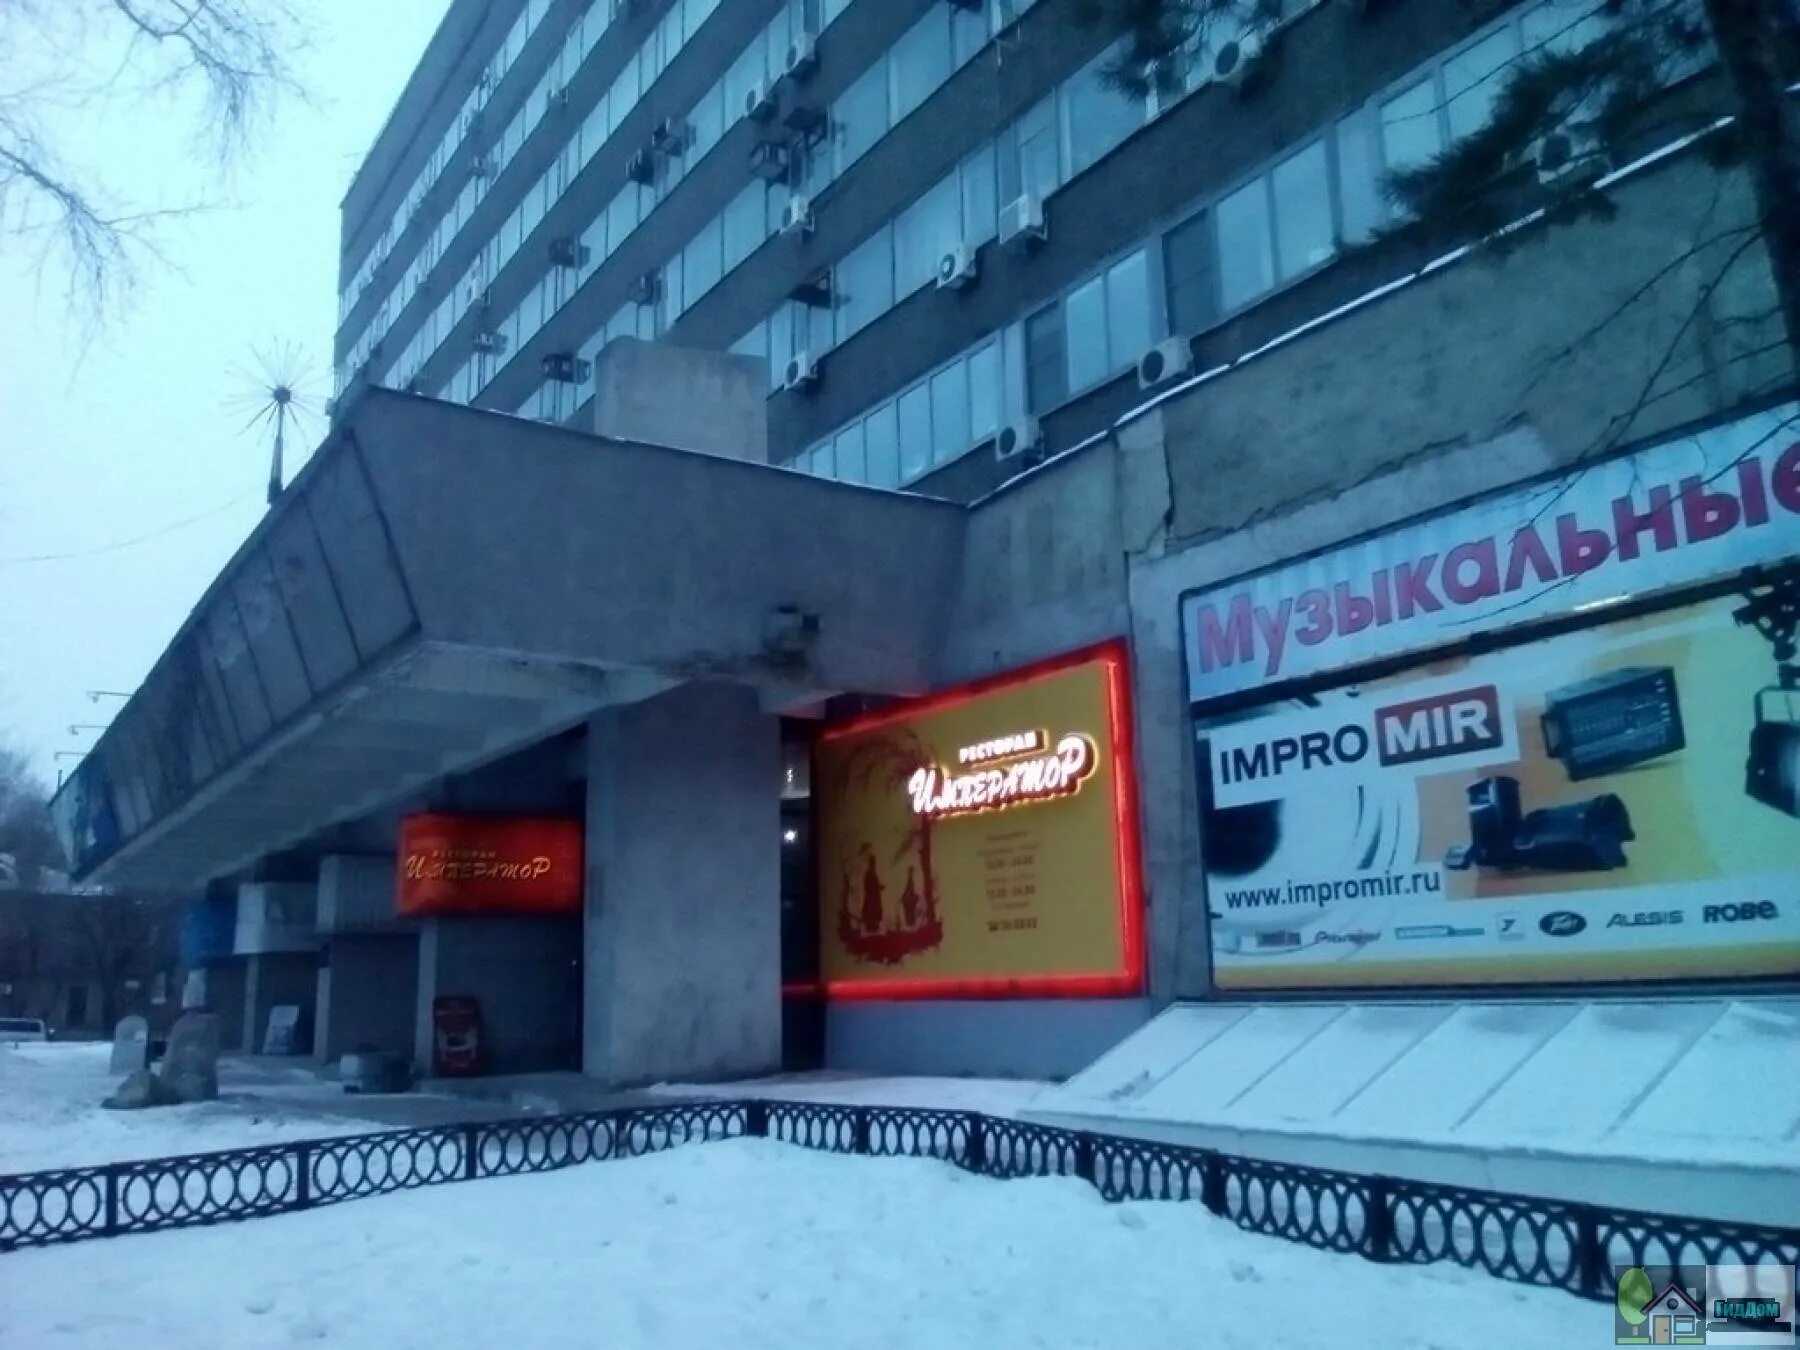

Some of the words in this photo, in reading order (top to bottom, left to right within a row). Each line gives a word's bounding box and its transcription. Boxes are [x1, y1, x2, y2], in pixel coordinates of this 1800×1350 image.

[958, 730, 1039, 763] РЕСТОРАН
[1220, 723, 1370, 785] IMPRO
[1383, 699, 1492, 756] MIR
[1224, 869, 1441, 909] www.impromir.ru
[1604, 909, 1686, 929] ALESIS
